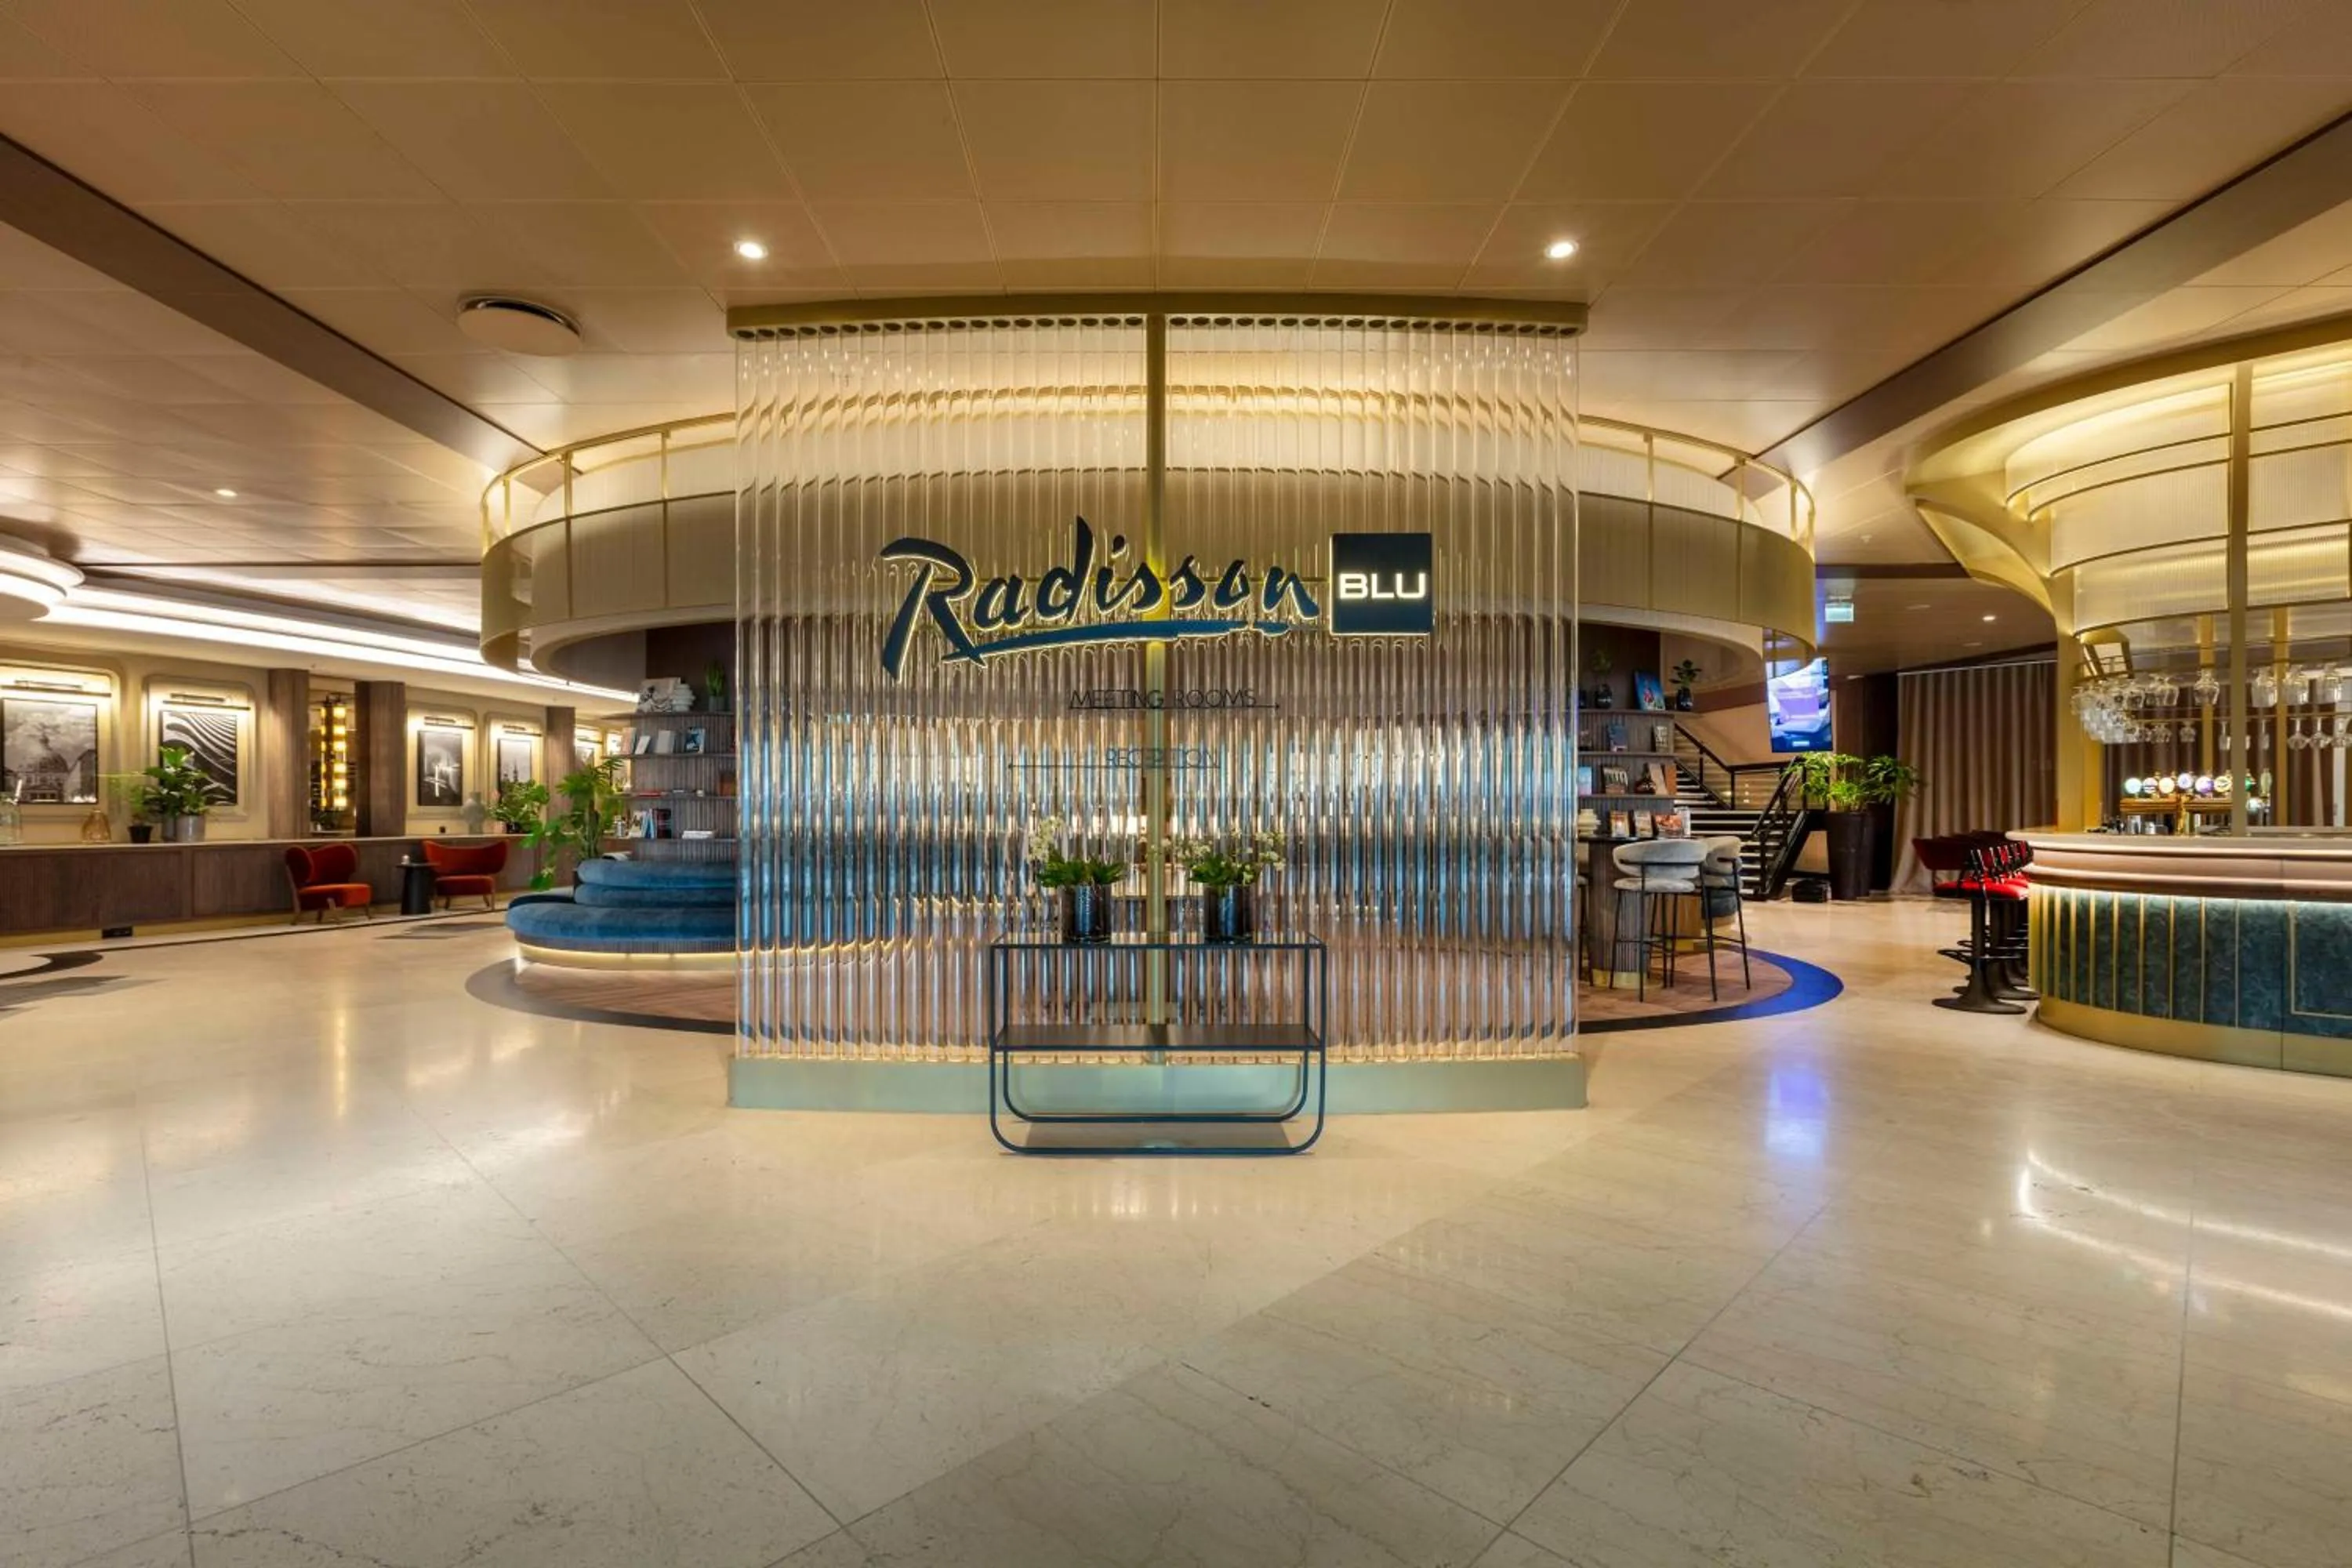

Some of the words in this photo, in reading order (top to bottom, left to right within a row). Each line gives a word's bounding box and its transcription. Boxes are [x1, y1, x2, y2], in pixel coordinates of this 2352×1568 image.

[880, 515, 1320, 684] Radisson
[1339, 573, 1427, 599] BLU
[1071, 689, 1164, 707] MEETING
[1174, 689, 1256, 706] ROOMS
